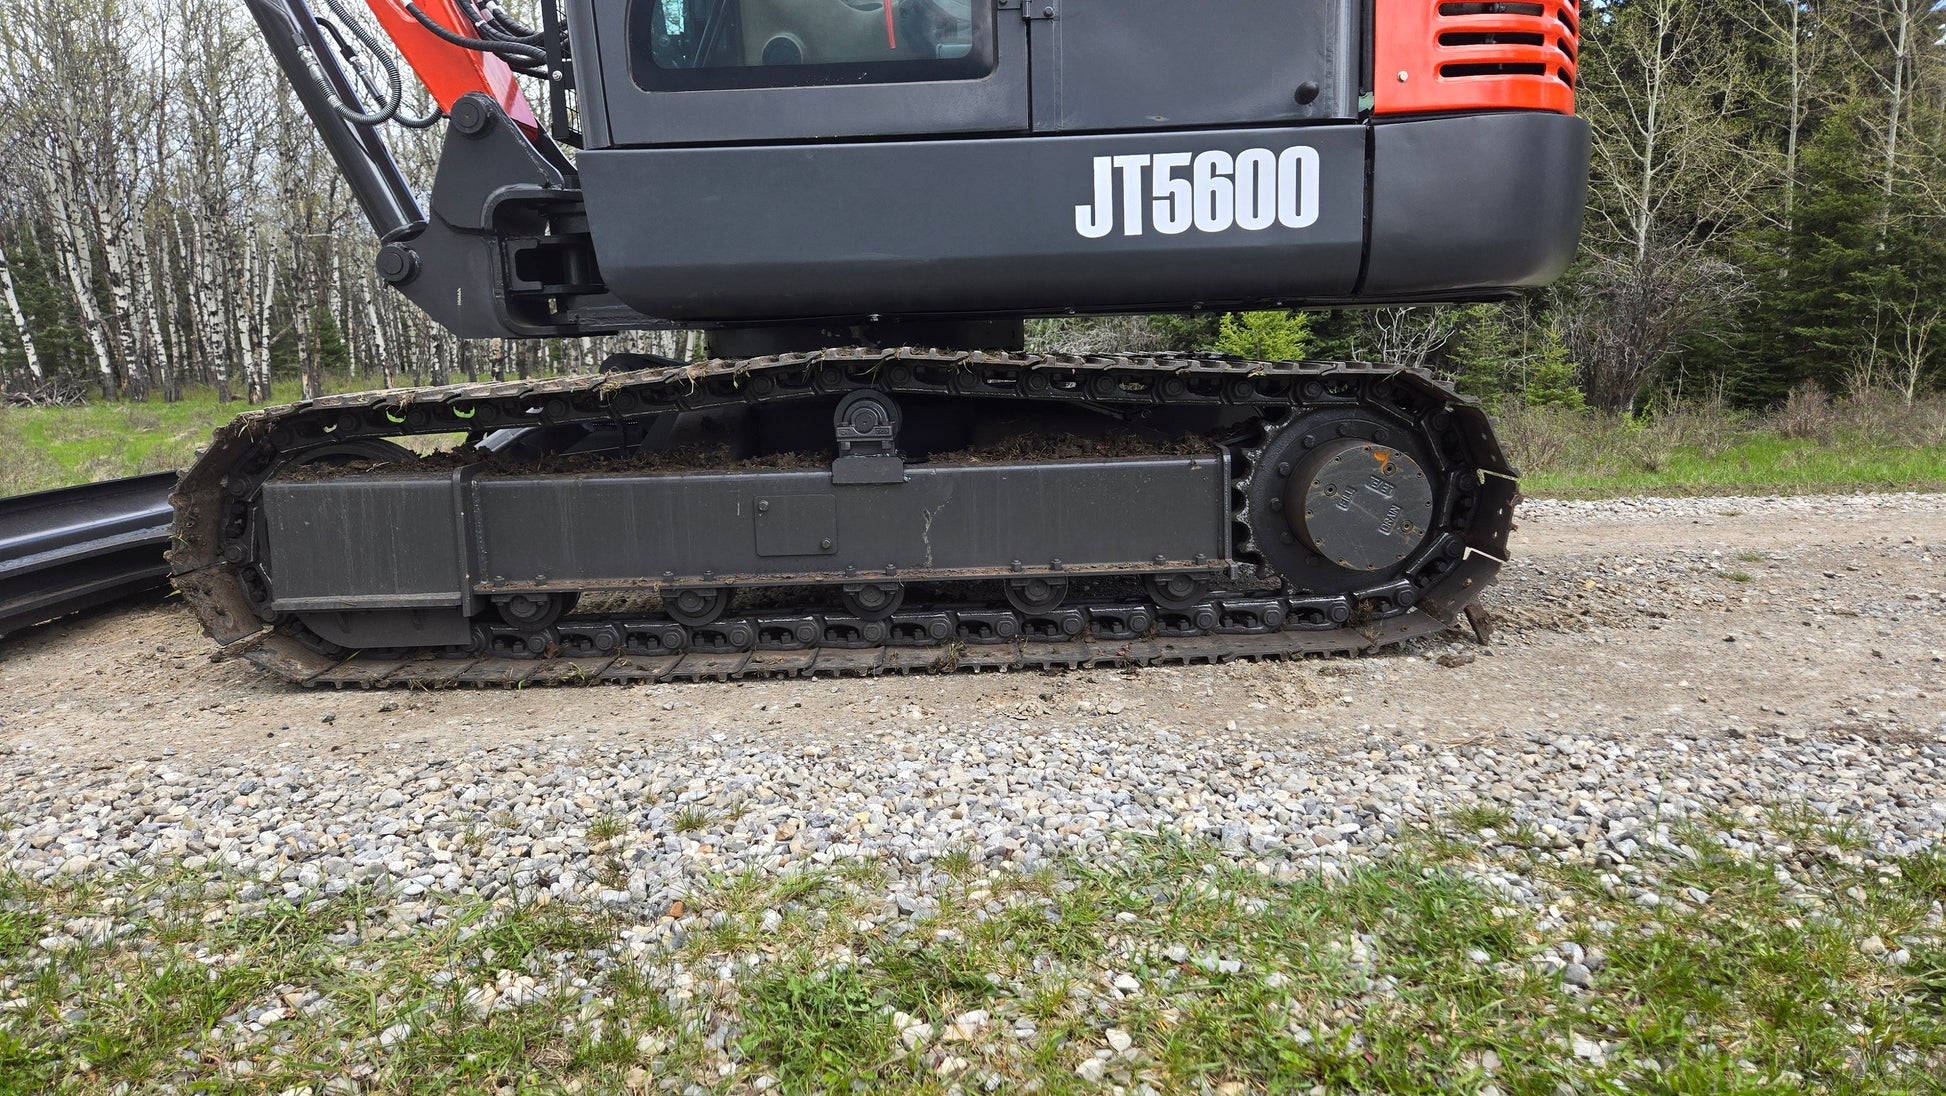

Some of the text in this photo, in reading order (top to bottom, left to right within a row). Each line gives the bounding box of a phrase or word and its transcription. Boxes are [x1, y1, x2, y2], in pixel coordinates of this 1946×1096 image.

[1075, 146, 1320, 238] JT5600
[1338, 486, 1357, 510] FILL
[1380, 503, 1402, 533] DRAIN
